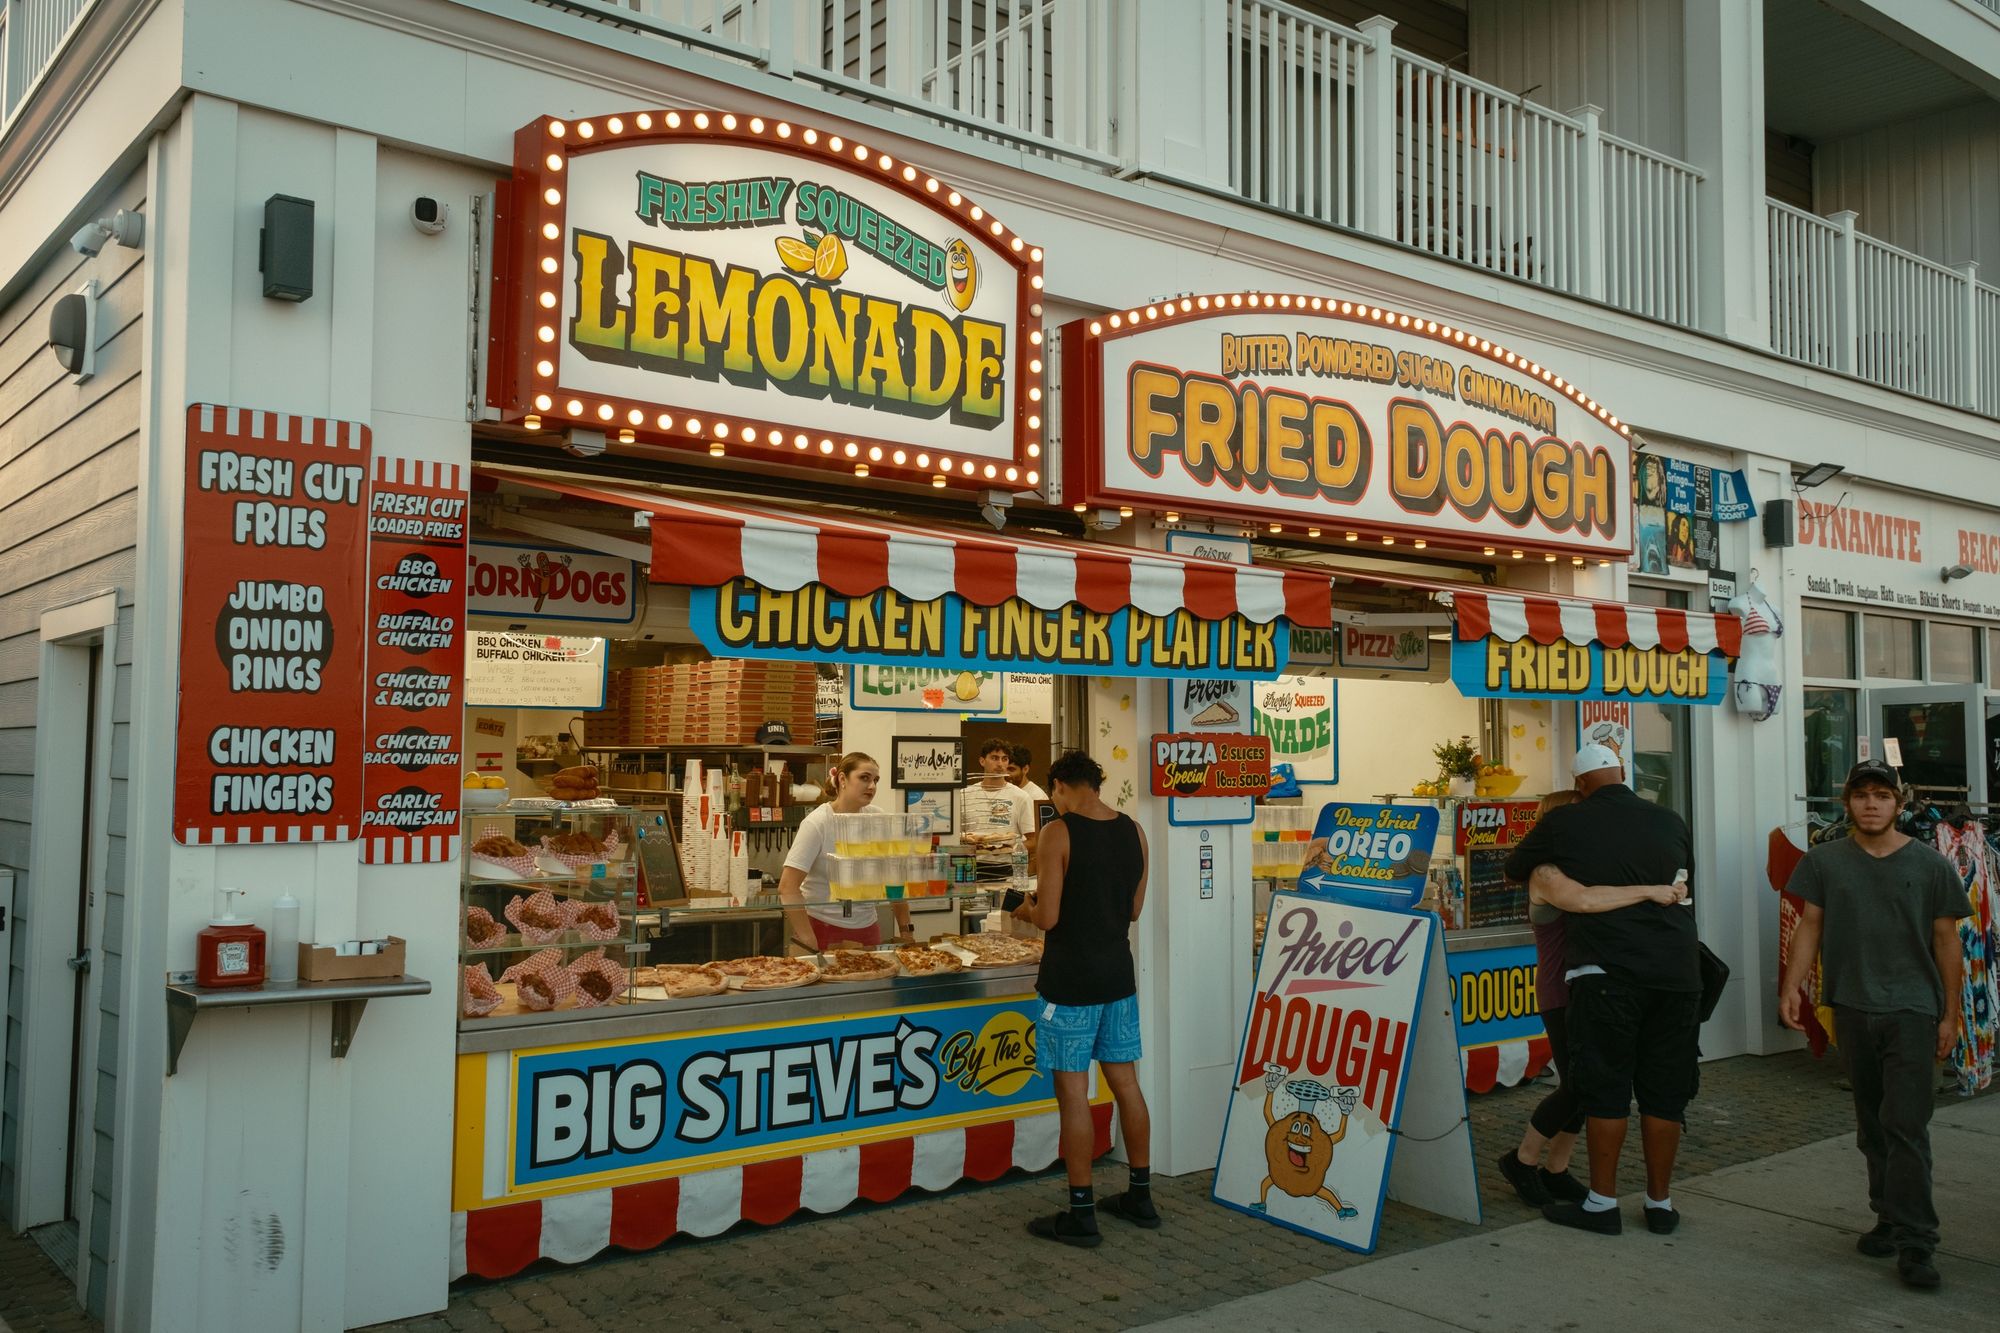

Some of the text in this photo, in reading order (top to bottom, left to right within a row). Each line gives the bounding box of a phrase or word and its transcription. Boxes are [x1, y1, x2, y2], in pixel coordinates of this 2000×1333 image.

[638, 172, 946, 287] FRESHLY SQUEEZED
[573, 231, 1003, 424] LEMONADE
[1223, 334, 1556, 431] BUTTER POWDERED SUGAR CINNAMON
[1130, 364, 1612, 533] FRIED DOUGH
[201, 451, 363, 503] FRESH CUT
[1670, 459, 1690, 472] Relax
[372, 492, 465, 518] FRESH CUT
[234, 502, 327, 549] FRIES
[370, 517, 463, 539] LOADED FRIES
[1797, 498, 1921, 563] DYNAMITE
[1957, 528, 2000, 575] BEAC
[399, 560, 437, 576] BBQ
[229, 581, 323, 613] JUMBO
[376, 576, 452, 593] CHICKEN
[548, 562, 627, 606] DOGS
[1712, 582, 1732, 596] beer
[1807, 575, 1831, 594] Sandals
[1833, 578, 1854, 596] Towels
[1880, 585, 1894, 602] Hats
[1919, 590, 1939, 607] Bikini
[1941, 594, 1961, 610] Shorts
[377, 614, 454, 632] BUFFALO
[717, 576, 942, 653] CHICKEN
[962, 597, 1112, 664] FINGER
[229, 617, 323, 652] ONION
[377, 632, 453, 648] CHICKEN
[477, 636, 541, 649] BBQ CHICKEN
[1346, 627, 1395, 658] PIZZA
[476, 649, 566, 662] BUFFALO CHICKEN
[1487, 635, 1709, 697] FRIED DOUGH
[232, 654, 322, 691] RINGS
[375, 673, 452, 690] CHICKEN
[1038, 676, 1052, 686] CHIC
[374, 690, 451, 707] & BACON
[1294, 692, 1326, 709] SQUEEZED
[1583, 701, 1630, 730] DOUGH
[210, 728, 334, 766] CHICKEN
[375, 734, 452, 750] CHICKEN
[1157, 741, 1218, 766] PIZZA
[1220, 745, 1266, 761] 2 SLICES
[364, 752, 460, 765] BACON RANCH
[1240, 762, 1248, 774] &
[1162, 762, 1211, 790] Special
[1216, 770, 1268, 788] 16oz SODA
[213, 775, 334, 813] FINGERS
[377, 794, 442, 809] GARLIC
[361, 810, 457, 826] PARMESAN
[1334, 807, 1421, 835] Deep Fried
[1462, 807, 1506, 829] PIZZA
[1511, 806, 1537, 822] 2 SLIC
[1327, 829, 1412, 862] OREO
[1464, 824, 1501, 846] Special
[1330, 854, 1395, 881] Cookies
[1265, 907, 1424, 1001] Fried
[1461, 966, 1539, 1025] DOUGH
[1239, 991, 1409, 1128] DOUGH
[534, 1062, 664, 1165] BIG
[679, 1021, 940, 1140] STEVE'S
[940, 1030, 987, 1091] By
[990, 1029, 1021, 1068] The
